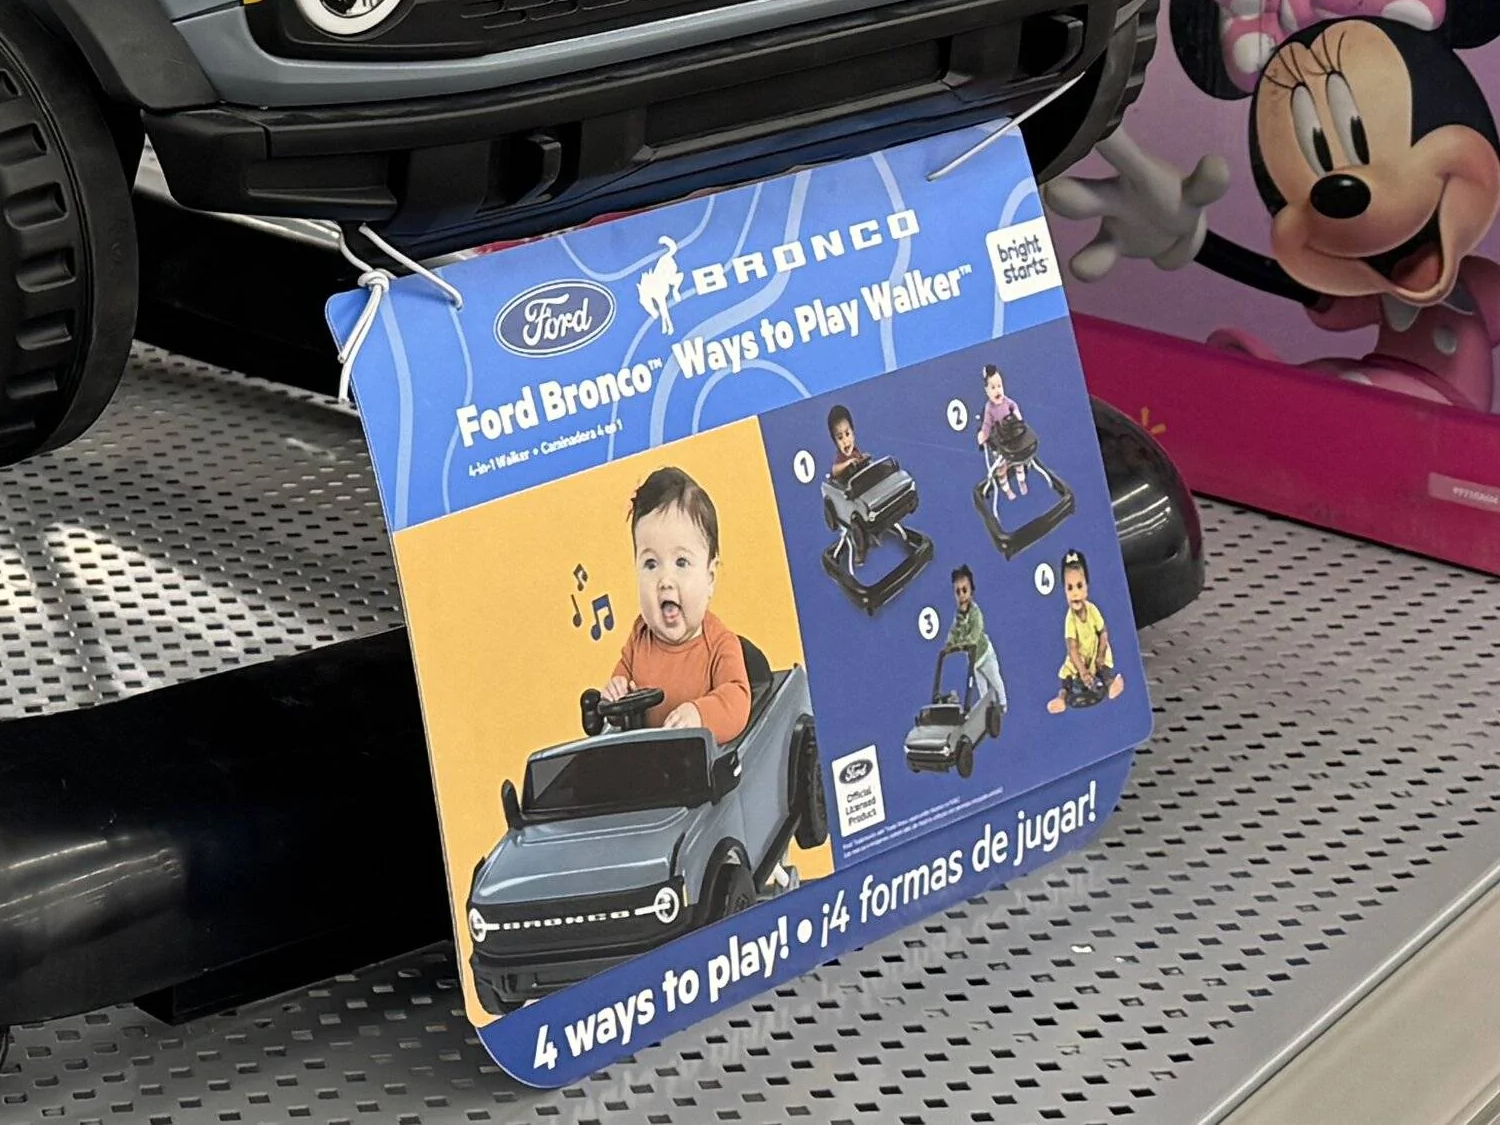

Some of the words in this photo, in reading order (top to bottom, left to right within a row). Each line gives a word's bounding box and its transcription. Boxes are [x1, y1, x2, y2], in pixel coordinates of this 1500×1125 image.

[692, 209, 920, 295] BRONCO
[999, 234, 1042, 263] bright
[1003, 256, 1047, 284] starts
[522, 293, 593, 346] Ford
[456, 385, 540, 448] Ford
[671, 330, 760, 379] Ways
[760, 318, 794, 353] to
[794, 298, 859, 343] Play
[496, 449, 530, 469] Walker
[845, 797, 876, 815] Licensed
[847, 786, 872, 803] Official
[848, 809, 877, 826] Product
[533, 1024, 558, 1070] 4
[564, 988, 655, 1057] ways
[662, 968, 700, 1012] to
[708, 915, 790, 1003] play!
[859, 848, 963, 923] formas
[972, 823, 1009, 872] de
[1013, 780, 1097, 867] jugar!
